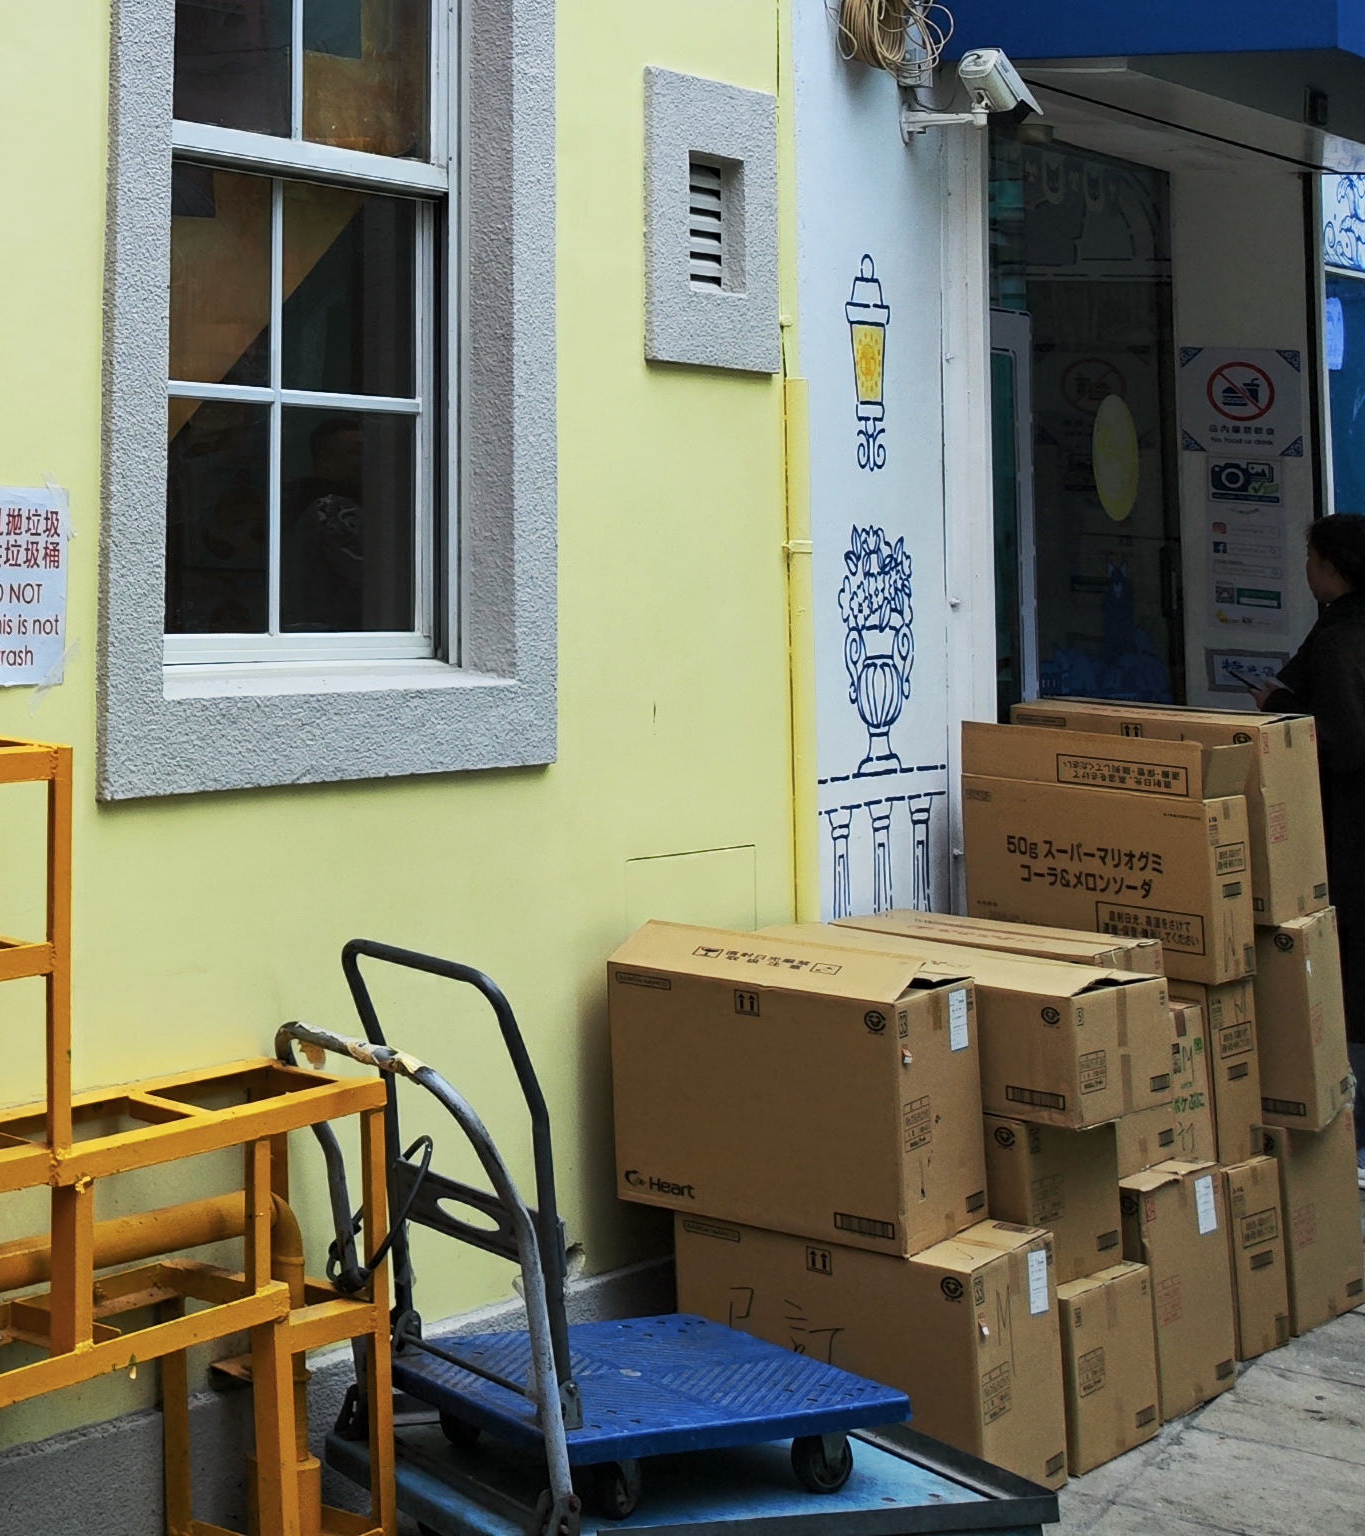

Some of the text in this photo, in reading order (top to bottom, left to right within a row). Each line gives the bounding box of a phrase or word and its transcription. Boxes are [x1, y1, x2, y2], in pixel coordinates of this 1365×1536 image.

[9, 583, 42, 604] NOT
[17, 614, 28, 635] is
[32, 616, 59, 635] not
[1006, 834, 1164, 875] 50g スーパーマリオグミ
[648, 1175, 696, 1200] Heart
